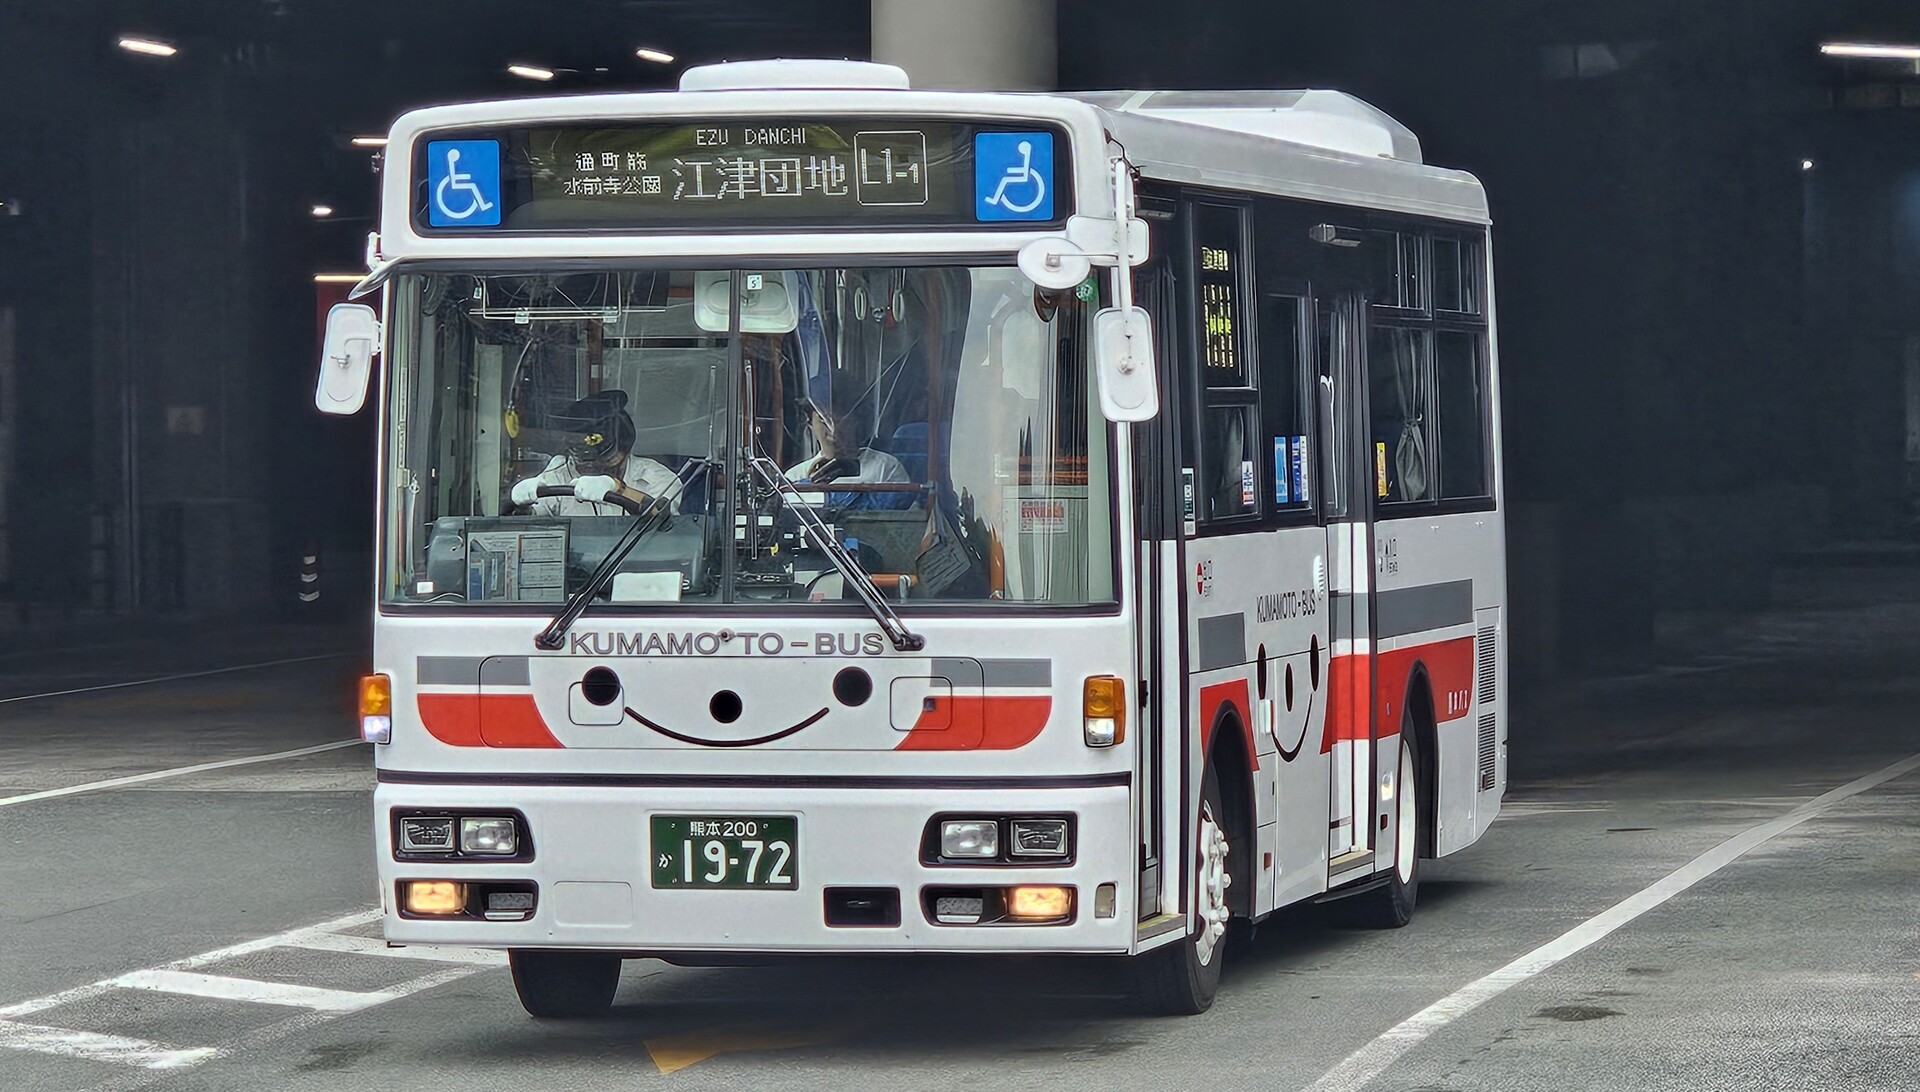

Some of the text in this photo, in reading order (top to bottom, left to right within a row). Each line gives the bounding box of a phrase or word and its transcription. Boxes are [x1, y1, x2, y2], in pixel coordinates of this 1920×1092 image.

[696, 127, 806, 146] EZU DANCHI
[671, 155, 849, 200] 江津団地
[861, 147, 919, 184] L1-1
[563, 175, 662, 196] 水前寺公園
[658, 839, 792, 884] か 19-72
